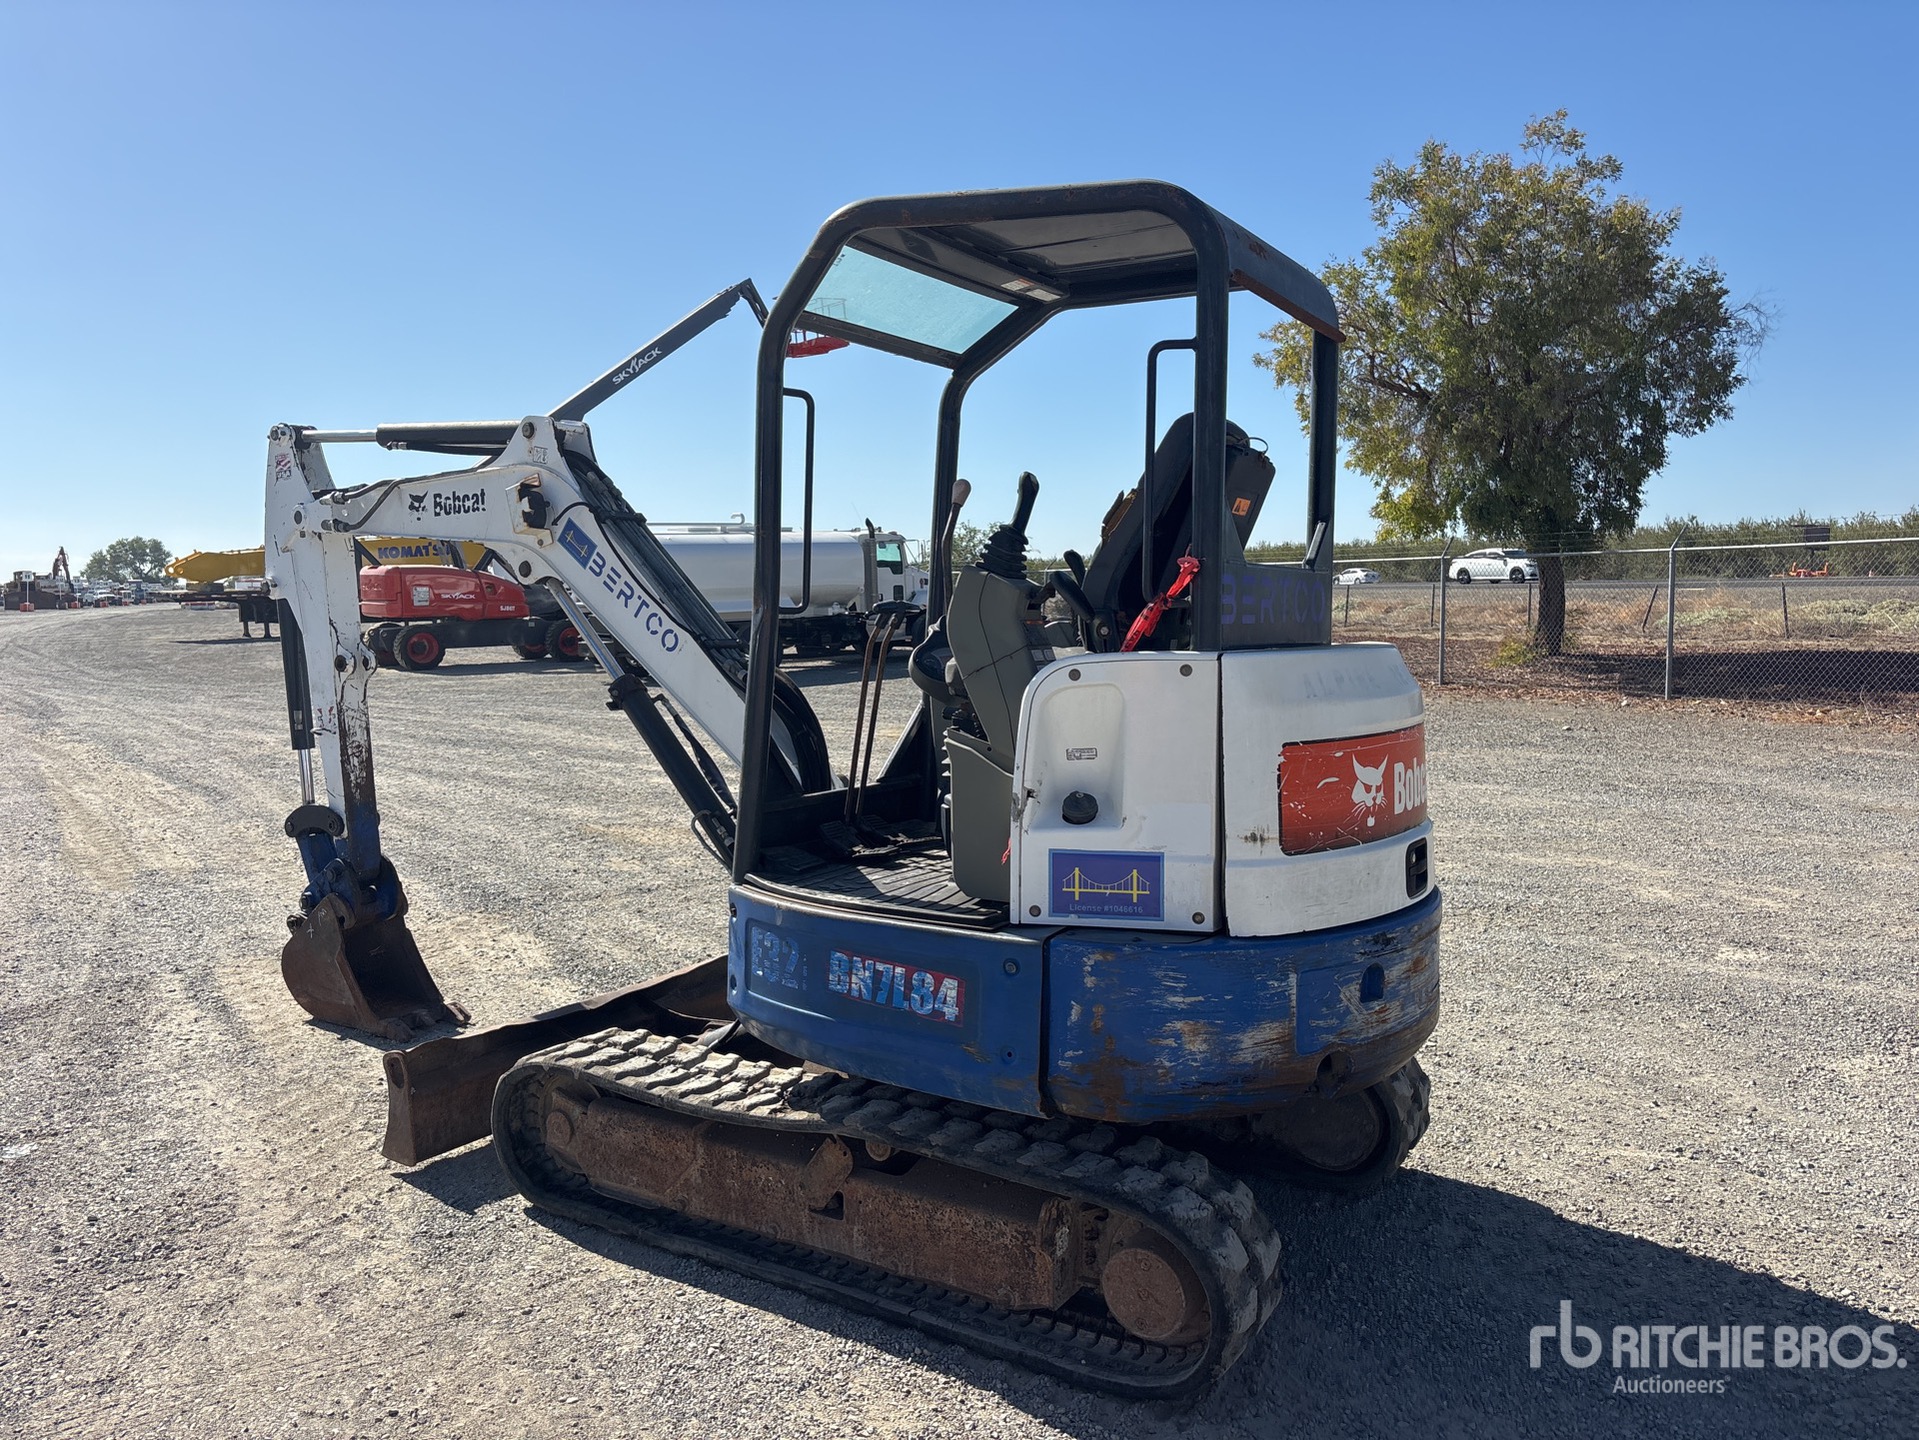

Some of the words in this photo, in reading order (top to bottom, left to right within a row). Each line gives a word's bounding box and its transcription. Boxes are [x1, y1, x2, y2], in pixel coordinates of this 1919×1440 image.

[612, 346, 662, 385] SKYJACK
[433, 488, 486, 517] Bobcat
[441, 591, 476, 600] SKYJACK
[588, 551, 679, 652] BERTCO
[1221, 573, 1326, 625] BERTCO
[1069, 903, 1102, 912] License
[828, 950, 959, 1022] BN7L84
